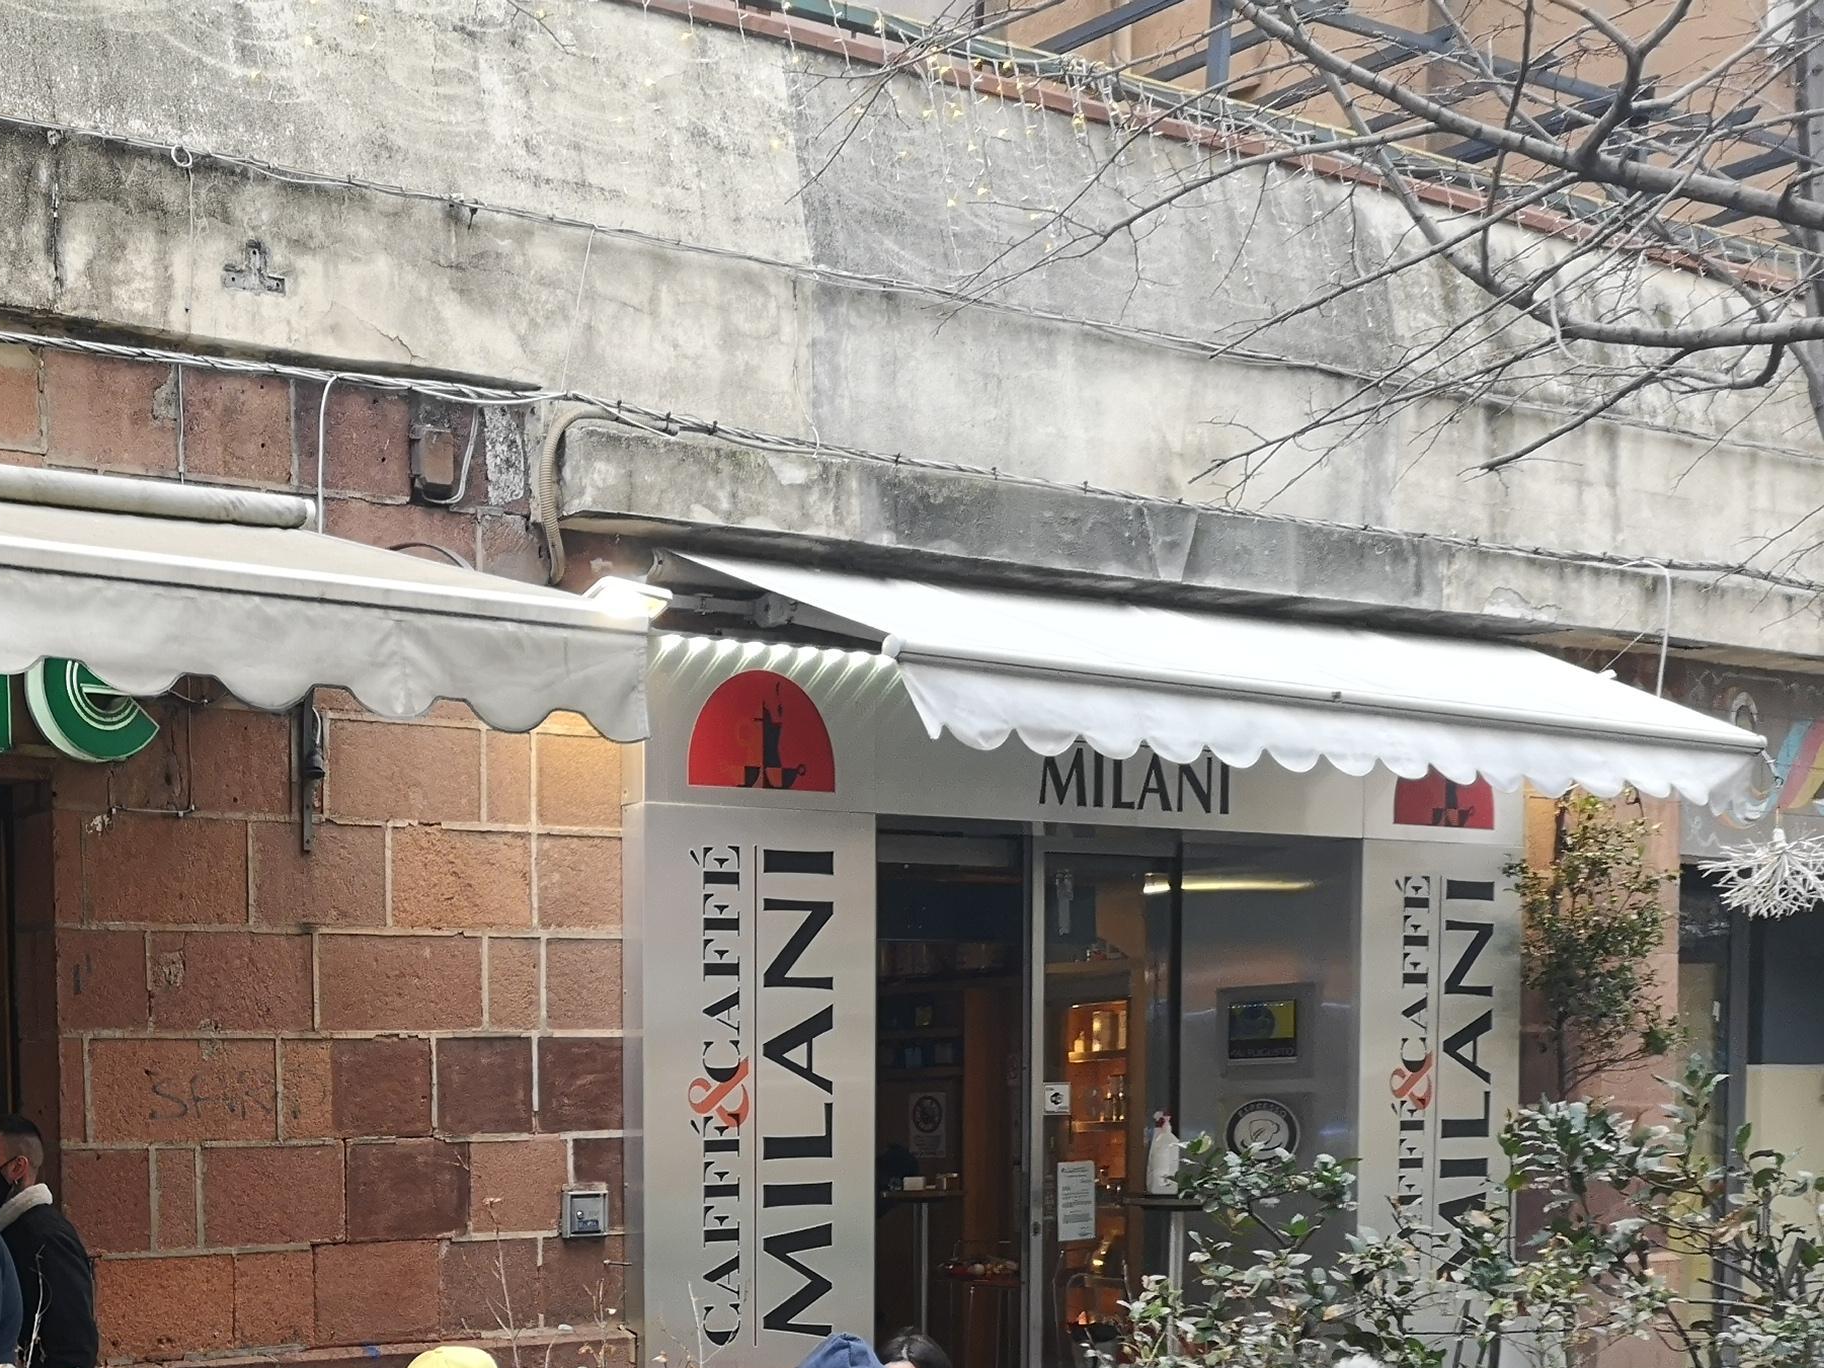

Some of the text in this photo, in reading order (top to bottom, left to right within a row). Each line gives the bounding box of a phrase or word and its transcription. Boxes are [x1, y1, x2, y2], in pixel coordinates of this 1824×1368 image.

[1039, 747, 1230, 814] MILANI
[688, 1055, 750, 1129] &
[763, 849, 834, 1337] MILANI
